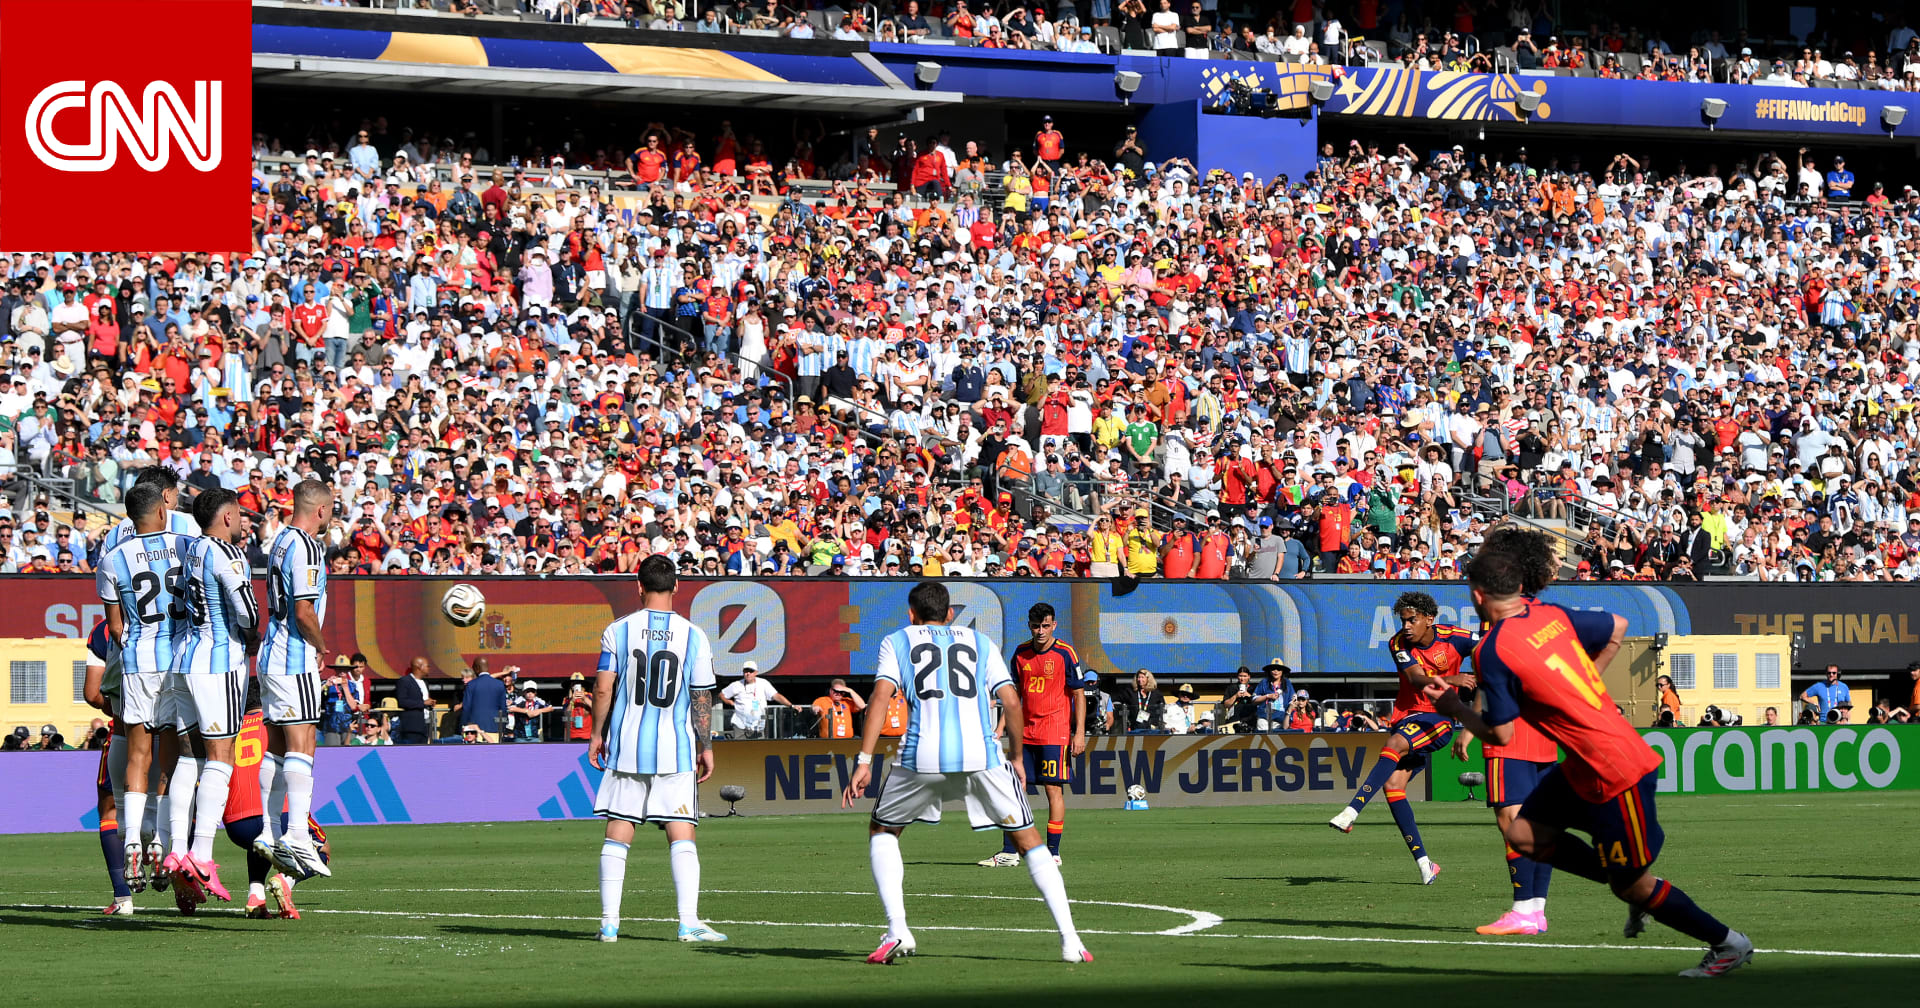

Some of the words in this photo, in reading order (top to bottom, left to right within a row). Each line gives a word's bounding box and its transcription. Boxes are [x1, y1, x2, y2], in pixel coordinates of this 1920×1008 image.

[1755, 99, 1866, 127] #FIFAWorldCup
[136, 547, 177, 564] MEDINA
[641, 628, 674, 642] MESSI
[918, 628, 965, 638] MOLINA
[1526, 619, 1567, 650] LAPORTE
[1733, 613, 1804, 637] THE
[1812, 613, 1919, 644] FINAL
[632, 648, 679, 708] 10
[910, 642, 977, 700] 26
[1028, 676, 1046, 694] 20
[1544, 639, 1607, 710] 14
[764, 753, 885, 801] NEW
[1178, 746, 1368, 794] JERSEY
[1042, 760, 1058, 778] 20
[1642, 727, 1902, 793] aramco
[1598, 840, 1628, 868] 14
